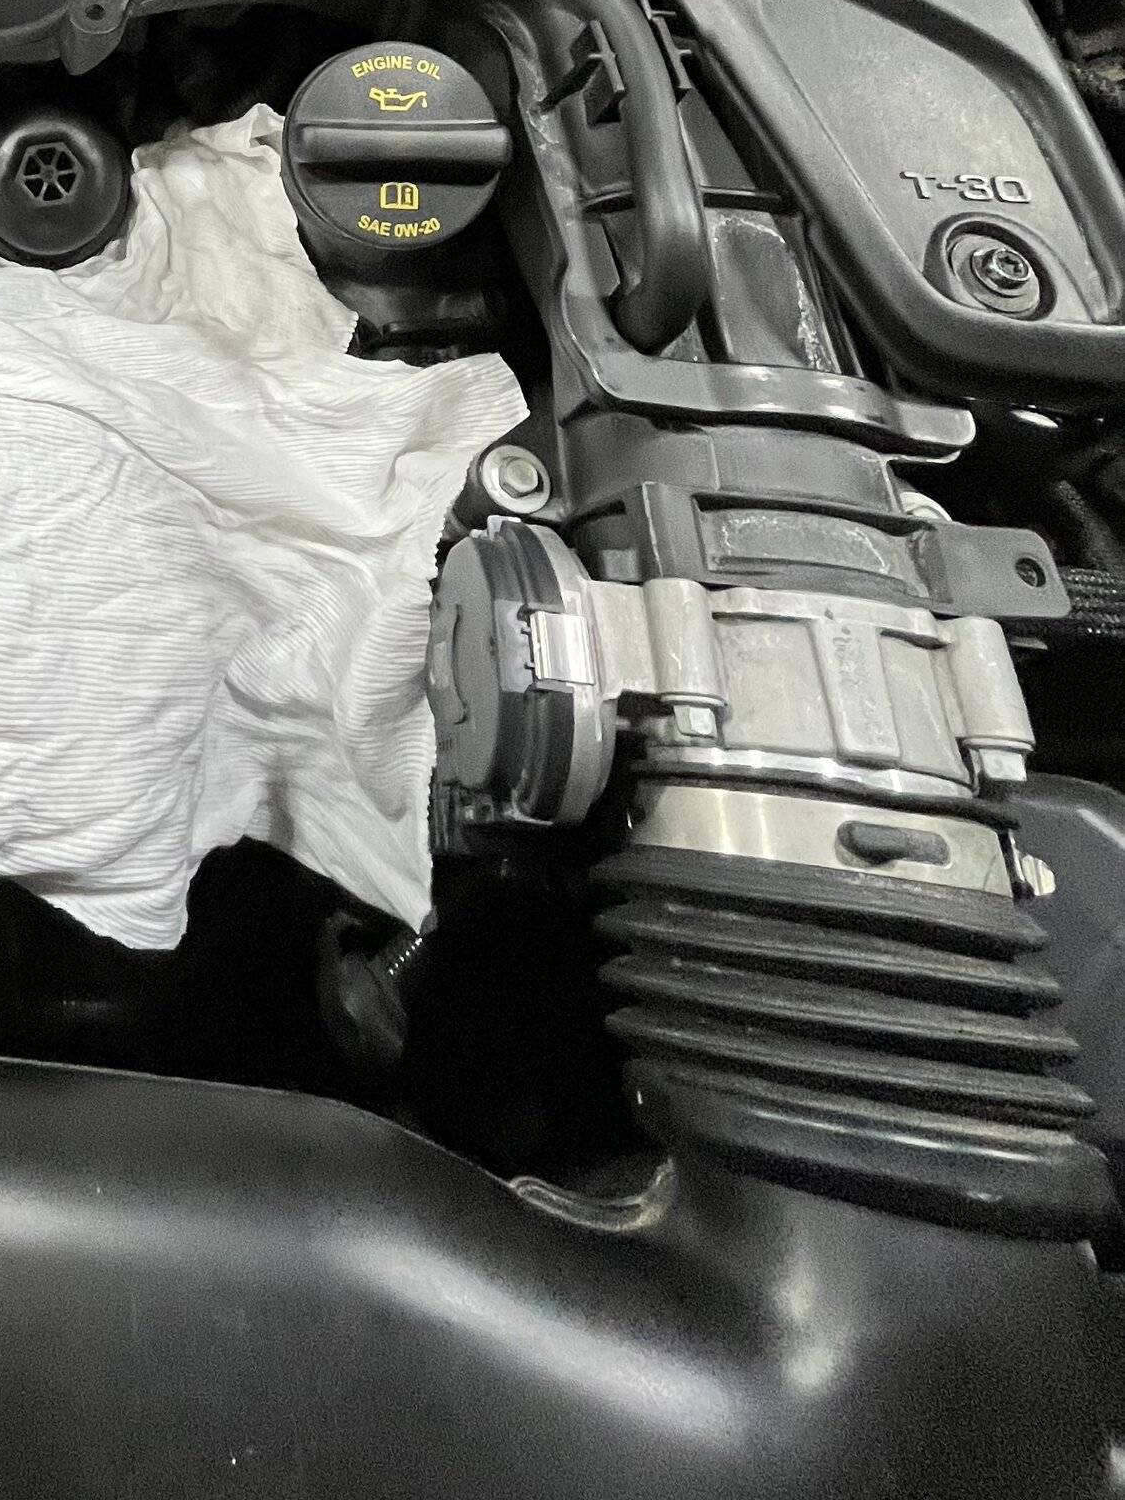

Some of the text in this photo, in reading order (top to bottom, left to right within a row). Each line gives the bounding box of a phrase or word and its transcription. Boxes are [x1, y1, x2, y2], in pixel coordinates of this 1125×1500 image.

[351, 55, 443, 80] ENGINE OIL
[899, 170, 1032, 203] T-30
[358, 215, 441, 238] SAE 0W-20
